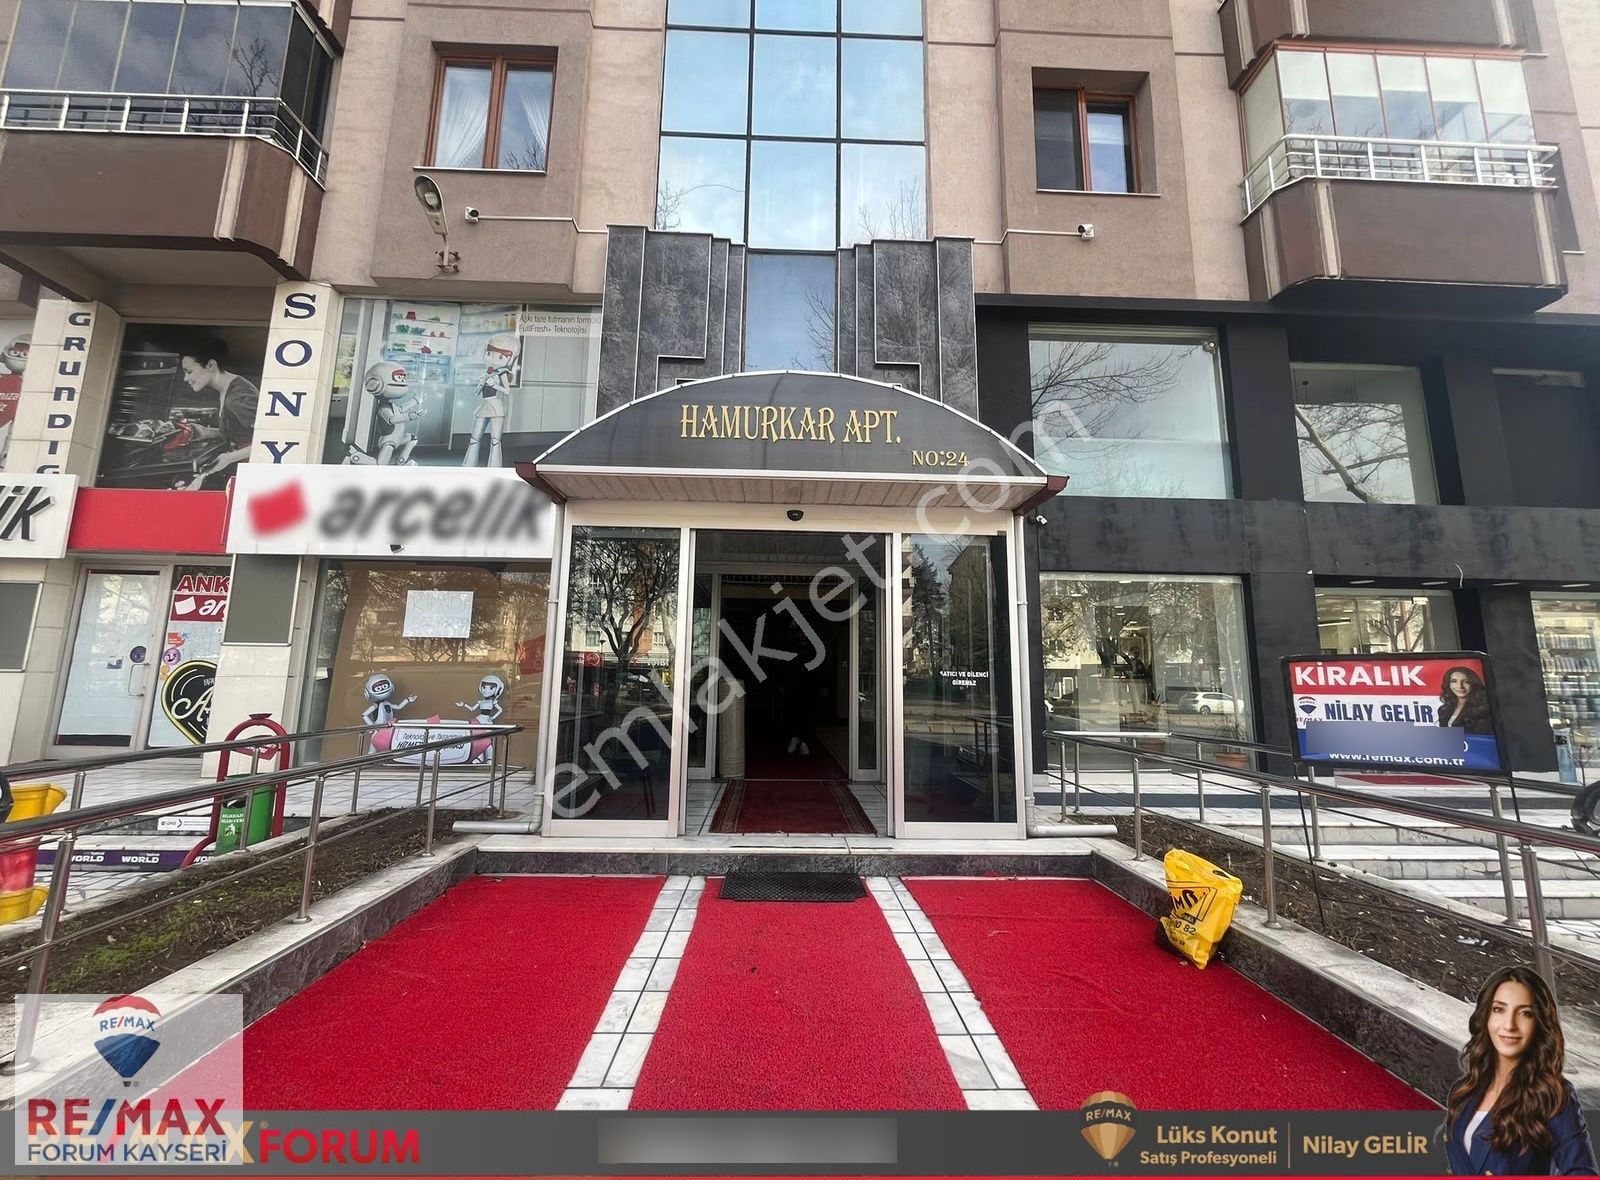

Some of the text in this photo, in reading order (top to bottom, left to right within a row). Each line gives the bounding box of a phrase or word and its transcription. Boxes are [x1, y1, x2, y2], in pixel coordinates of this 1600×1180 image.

[261, 292, 316, 464] SONY
[680, 404, 902, 444] HAMURKAR APT.
[911, 450, 970, 468] NO:24
[0, 485, 54, 540] ik
[1294, 661, 1427, 687] KİRALIK
[1324, 700, 1434, 724] NİLAY GELİR
[121, 855, 160, 864] WORLD
